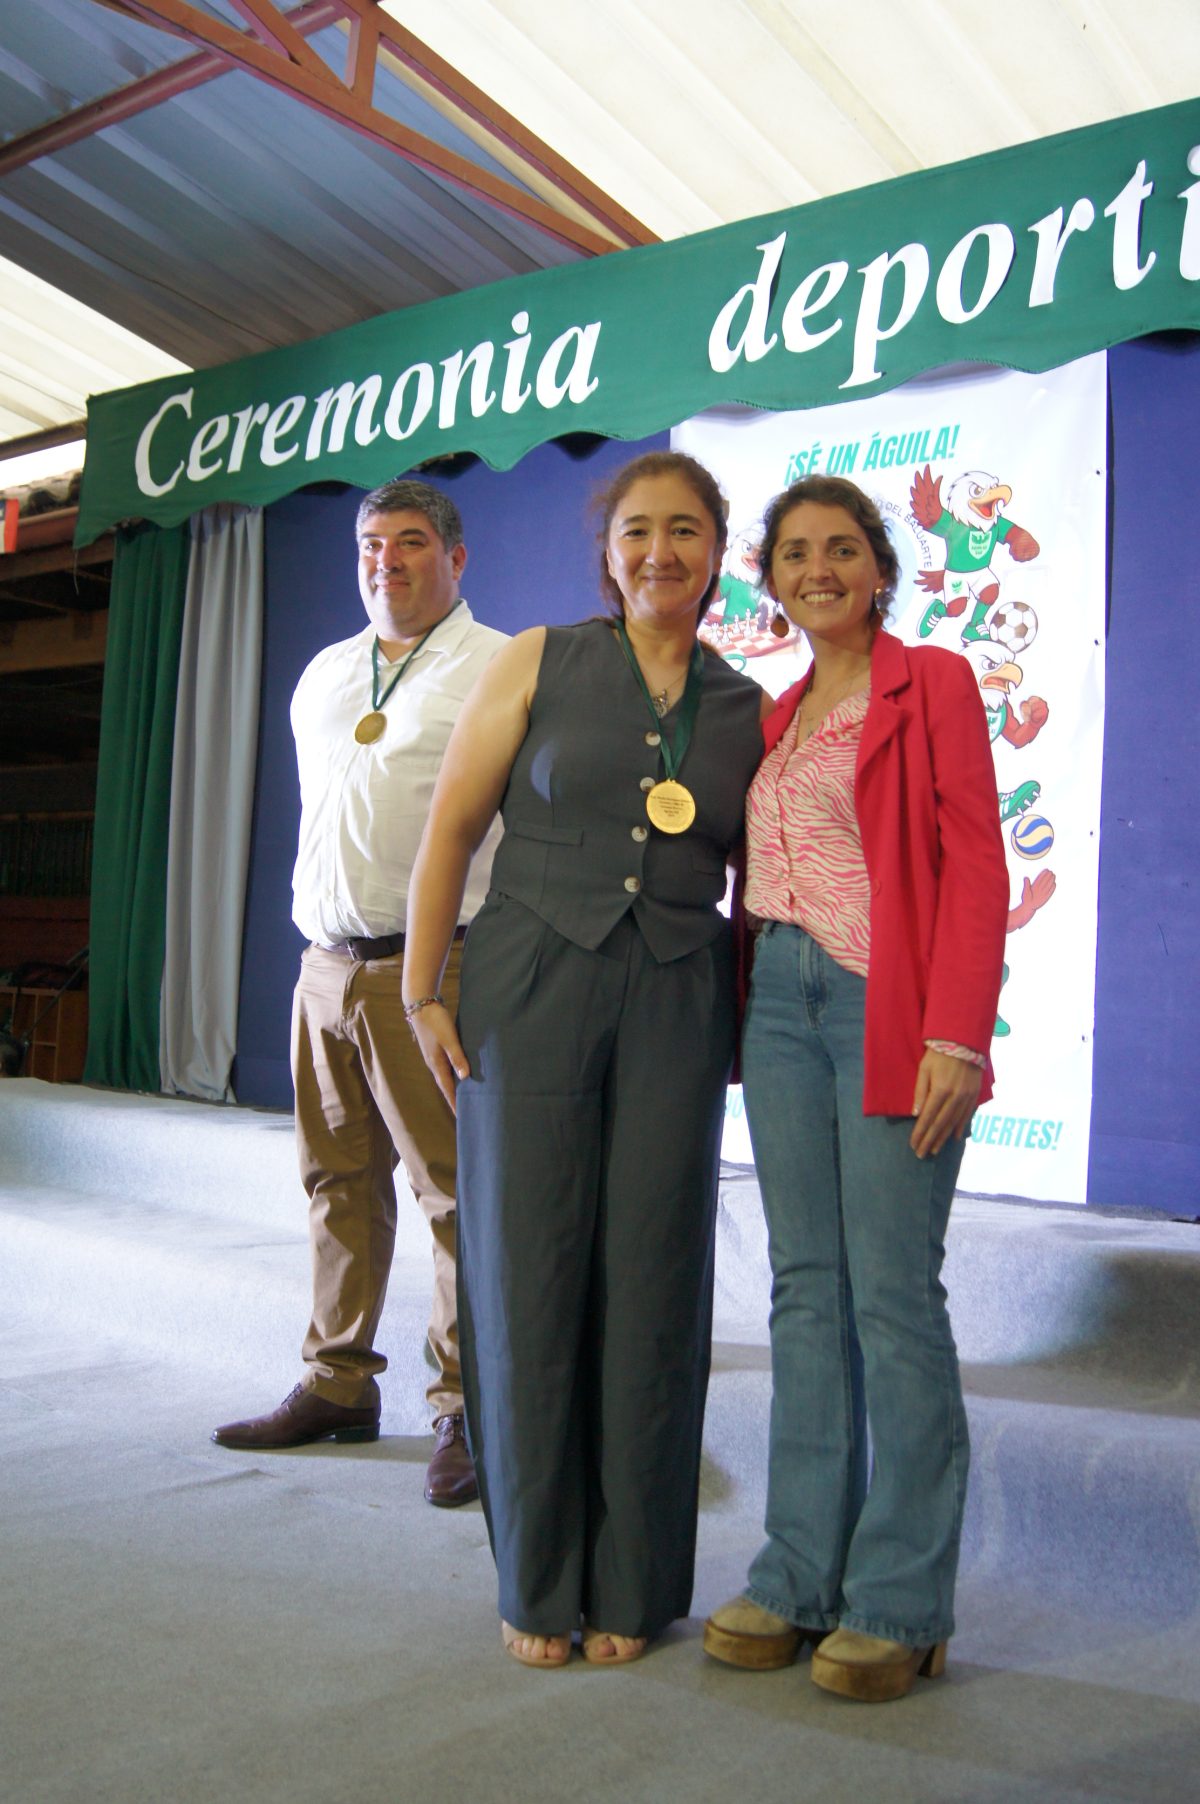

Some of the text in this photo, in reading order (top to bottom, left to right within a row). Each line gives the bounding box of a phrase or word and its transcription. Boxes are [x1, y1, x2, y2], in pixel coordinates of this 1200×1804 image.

[135, 310, 603, 498] Ceremonia
[825, 441, 861, 476] UN
[862, 423, 961, 473] ÁGUILA!
[885, 501, 933, 569] DEL BALUARTE
[971, 1114, 1064, 1151] UERTES!
